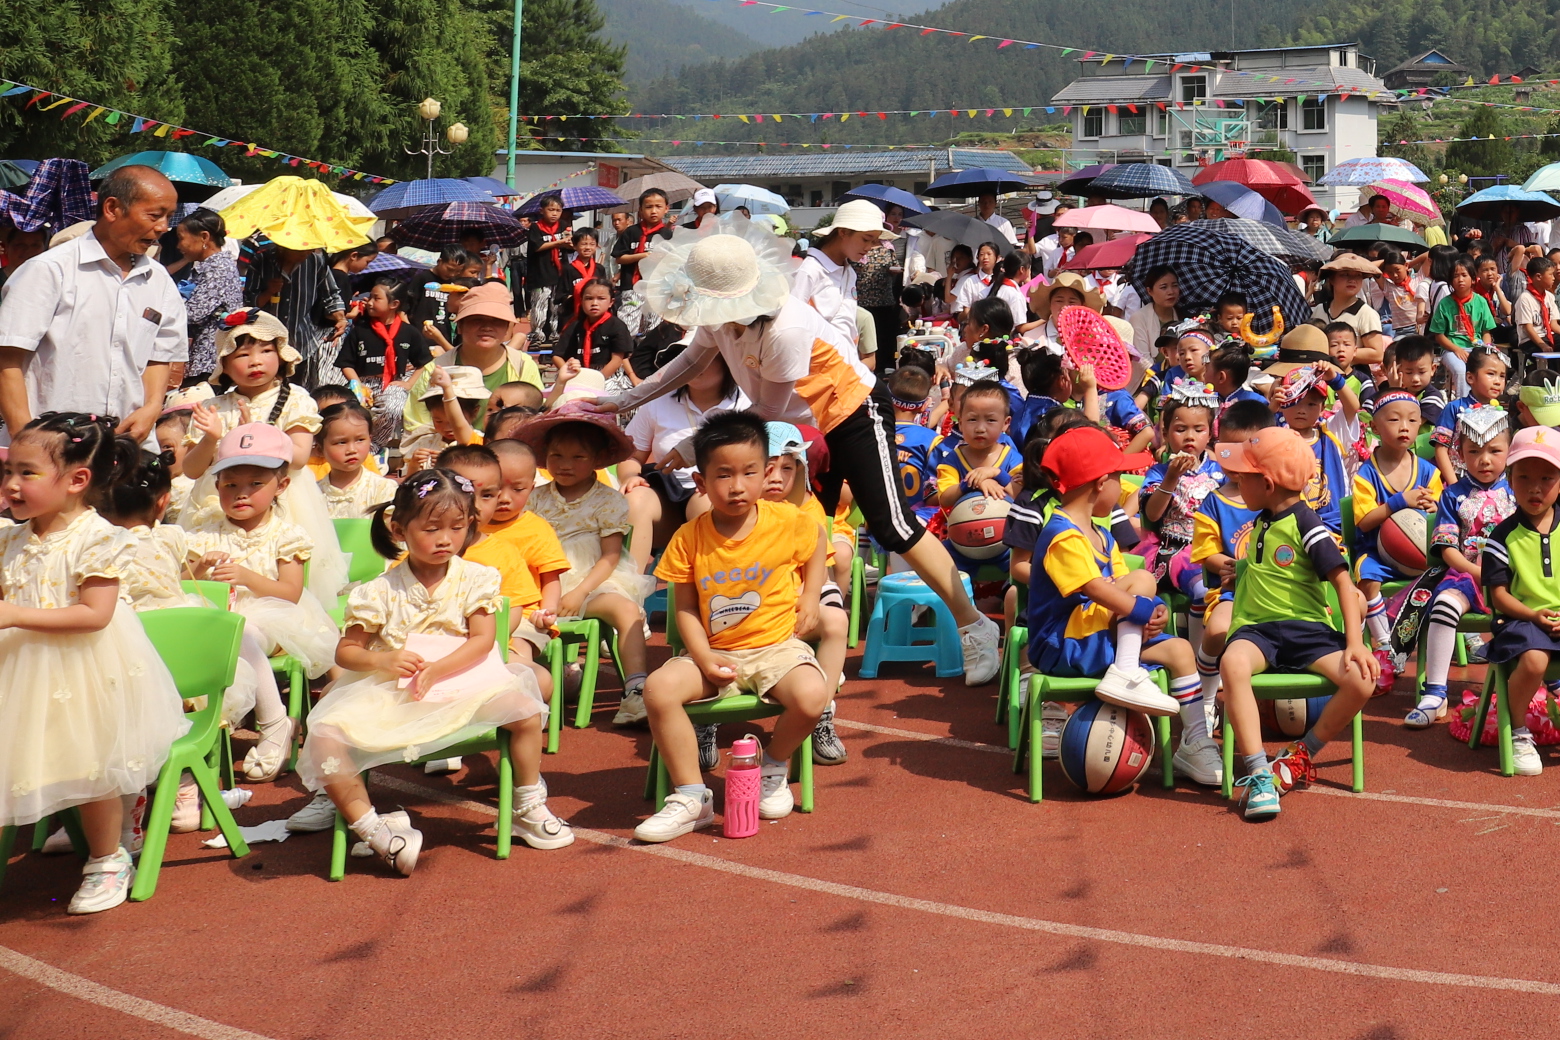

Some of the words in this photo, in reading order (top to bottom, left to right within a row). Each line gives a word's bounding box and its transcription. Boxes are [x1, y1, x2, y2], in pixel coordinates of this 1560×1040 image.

[239, 434, 255, 450] C
[1230, 520, 1254, 544] GOLDE
[700, 561, 775, 590] ready
